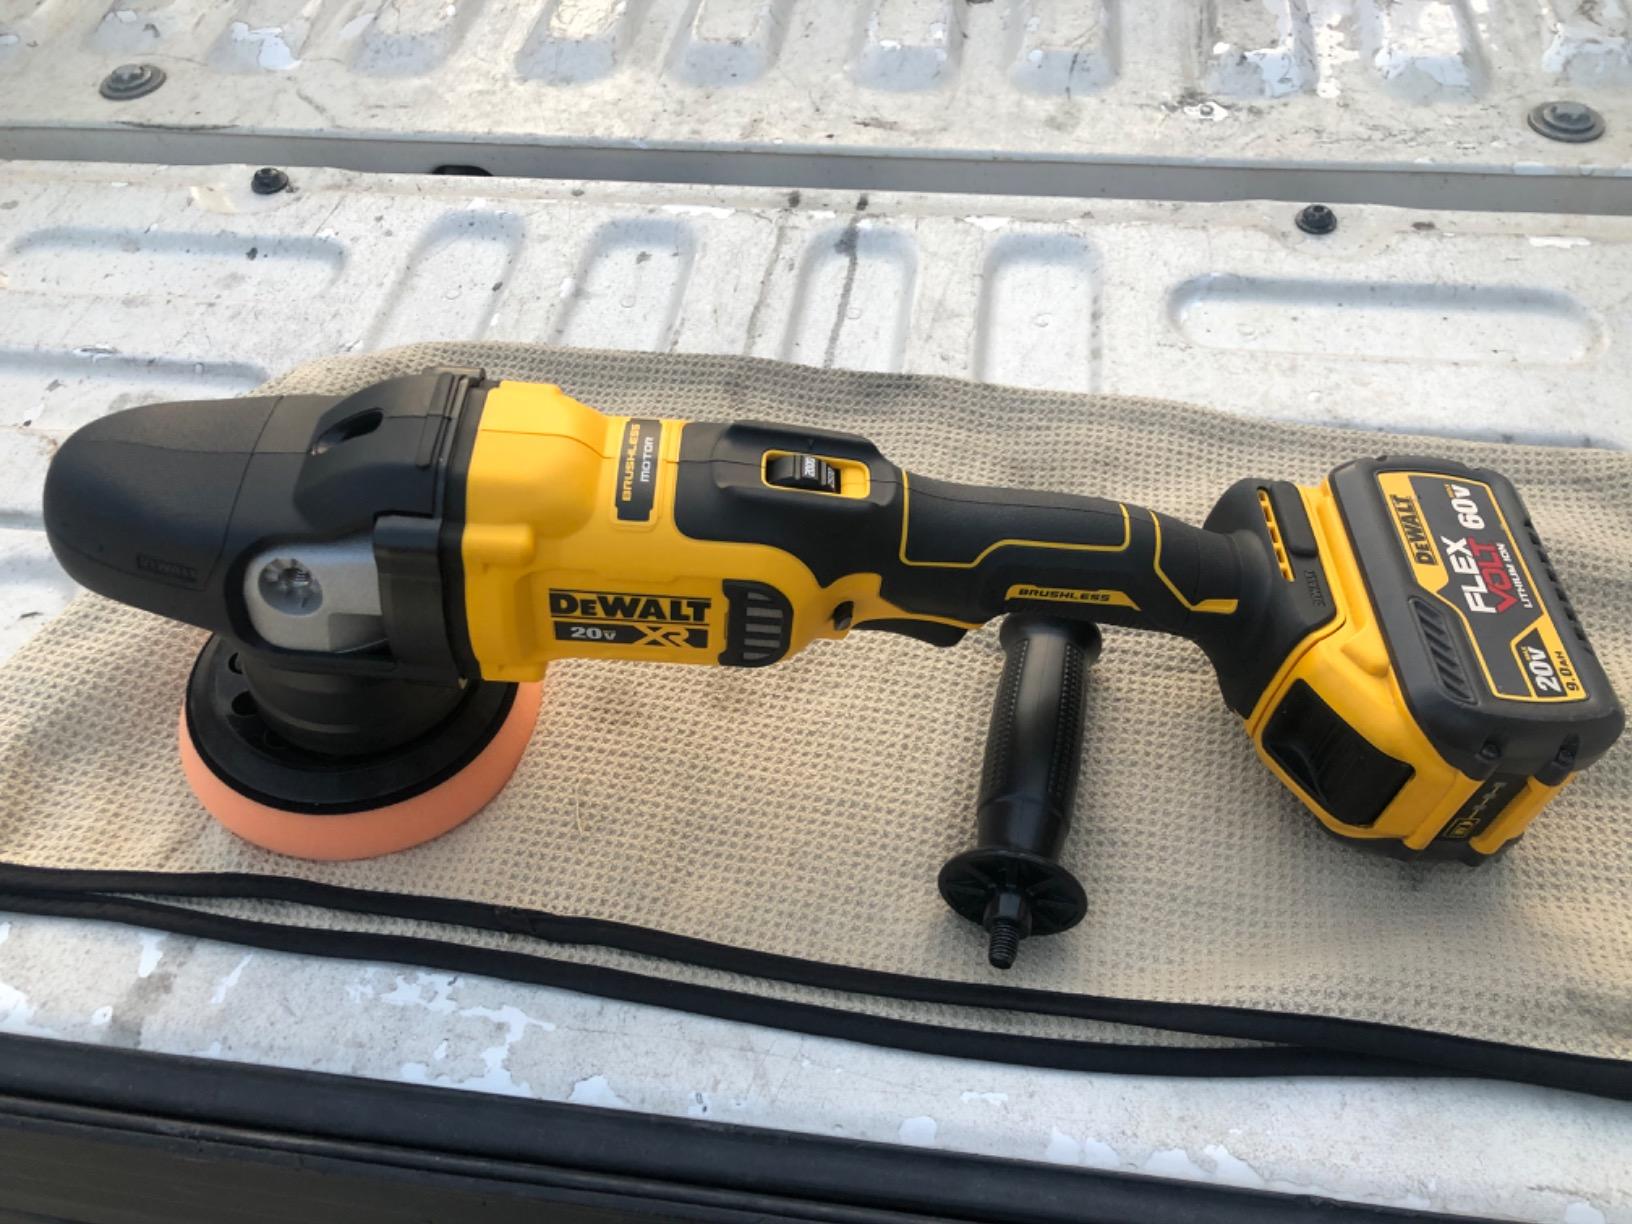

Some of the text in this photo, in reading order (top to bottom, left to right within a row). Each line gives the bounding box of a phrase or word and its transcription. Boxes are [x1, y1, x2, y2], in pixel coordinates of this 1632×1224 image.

[622, 424, 641, 501] BRUSHLESS
[640, 437, 655, 482] MOTOR
[1018, 588, 1111, 602] BRUSHLESS
[1441, 536, 1497, 613] FLEX
[1467, 535, 1519, 613] VOLT
[632, 625, 694, 648] XR
